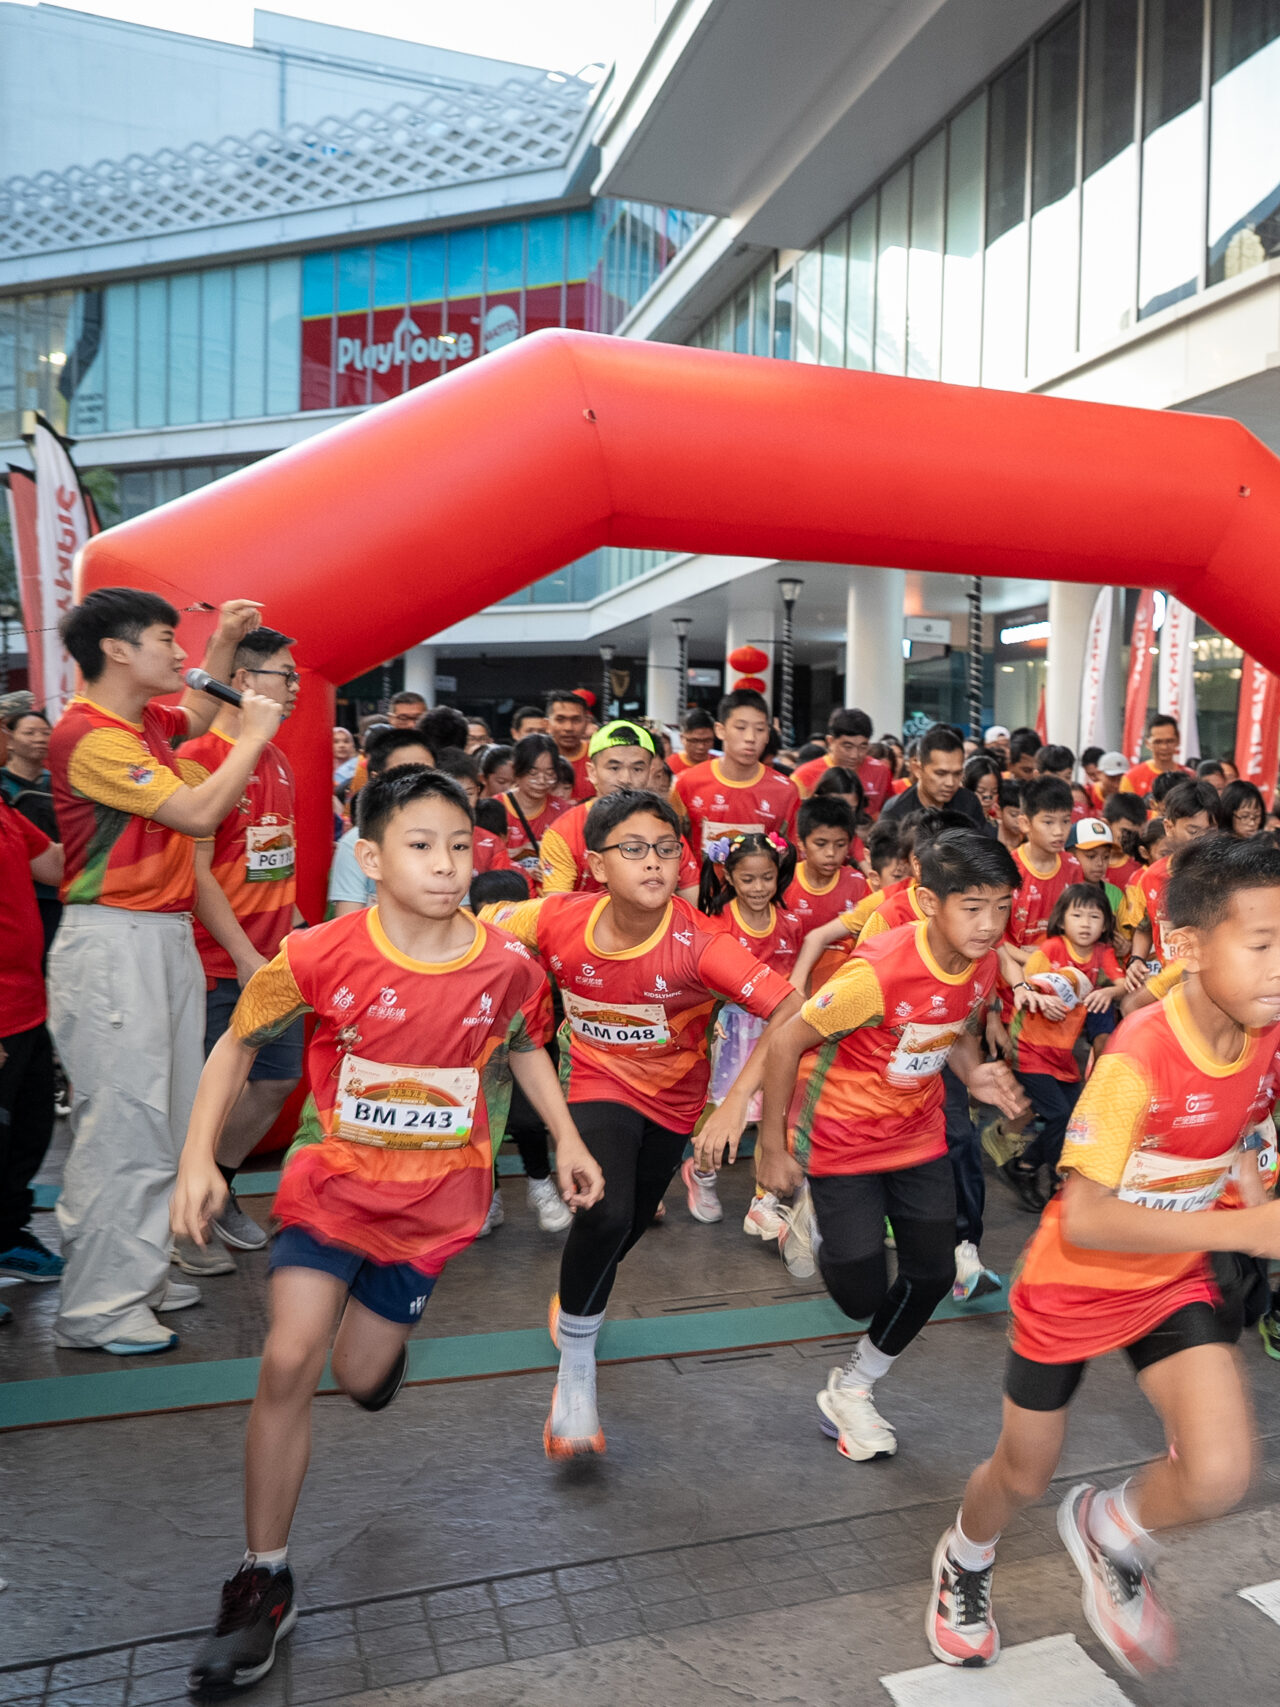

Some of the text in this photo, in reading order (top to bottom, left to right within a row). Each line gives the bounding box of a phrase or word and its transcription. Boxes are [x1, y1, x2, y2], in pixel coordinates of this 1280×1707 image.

[259, 854, 277, 866] PG
[644, 990, 682, 999] KIDSLYMPIC
[581, 1022, 655, 1041] AM 048
[905, 1056, 930, 1071] AF
[355, 1101, 453, 1129] BM 243
